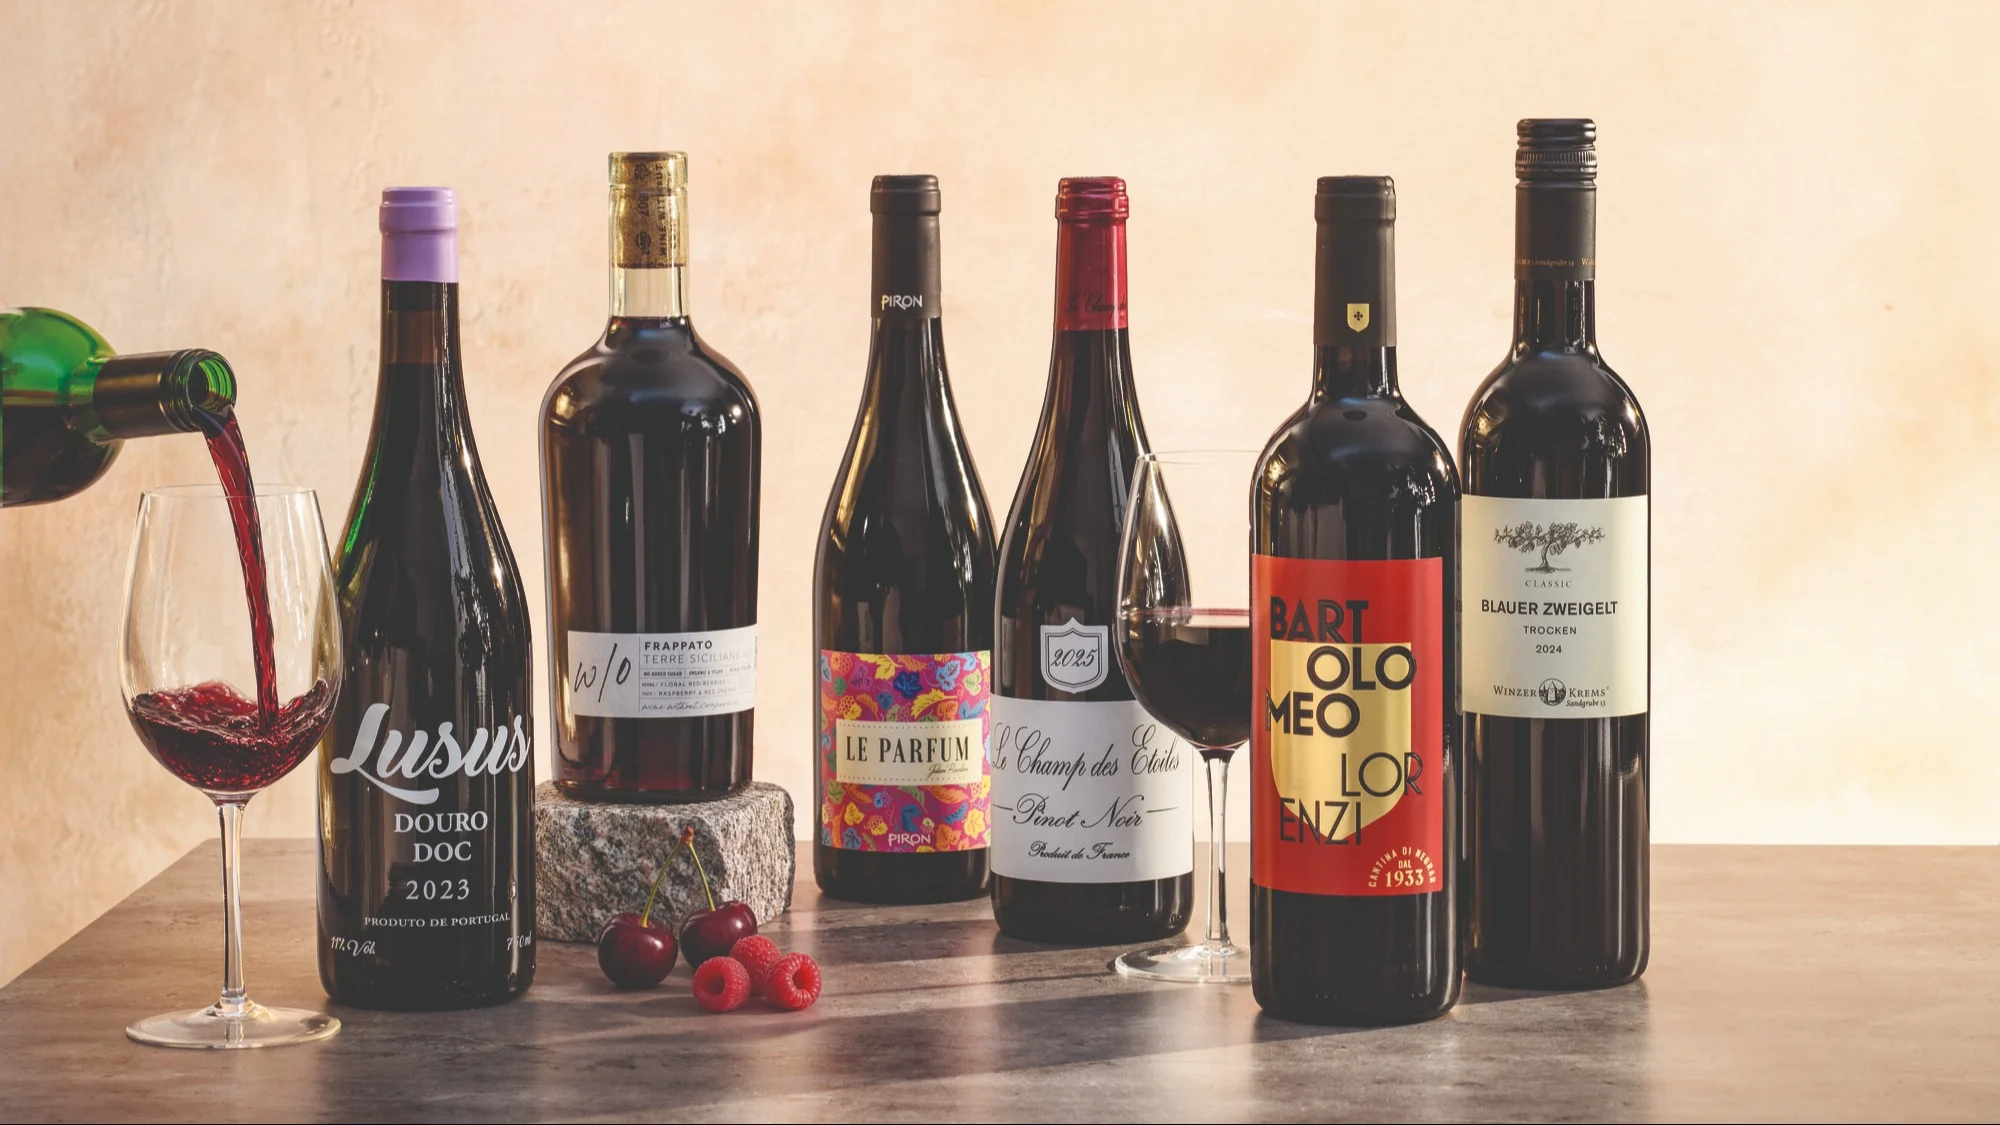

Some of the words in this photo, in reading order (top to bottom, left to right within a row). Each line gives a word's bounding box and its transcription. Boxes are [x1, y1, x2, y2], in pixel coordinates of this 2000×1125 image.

[881, 294, 923, 311] PIRON
[1525, 579, 1573, 589] CLASSIC
[1481, 599, 1538, 616] BLAUER
[1543, 601, 1618, 616] ZWEIGELT
[1269, 595, 1369, 644] BART
[1523, 625, 1577, 635] TROCKEN
[644, 640, 713, 651] FRAPPATO
[1535, 644, 1562, 654] 2024
[643, 653, 685, 665] TERRE
[689, 651, 740, 664] SICILIANE
[1050, 648, 1098, 668] 2025
[1306, 645, 1417, 691] OLO
[1265, 688, 1360, 738] MEO
[1565, 699, 1599, 709] Sandgrube
[330, 702, 531, 805] Lusus
[845, 735, 868, 762] LE
[879, 736, 969, 763] PARFUM
[992, 722, 1011, 771] Le
[1014, 725, 1087, 792] Champ
[1090, 743, 1119, 777] des
[1341, 751, 1423, 798] LOR
[1012, 792, 1080, 828] Pinot
[1080, 794, 1145, 829] Noir
[393, 810, 488, 833] DOURO
[1279, 797, 1362, 846] ENZI
[887, 832, 931, 847] PIRON
[413, 841, 472, 863] DOC
[1028, 840, 1073, 859] Produit
[1071, 847, 1085, 860] de
[1086, 841, 1131, 860] France
[1368, 849, 1398, 888] CANTINA
[1402, 846, 1412, 856] DI
[1415, 848, 1437, 884] NEGRAR
[1398, 859, 1412, 869] DAL
[1385, 868, 1424, 888] 1933
[406, 878, 470, 901] 2023
[364, 916, 426, 928] PRODUTO
[429, 917, 448, 928] DE
[451, 913, 511, 927] PORTUGAL
